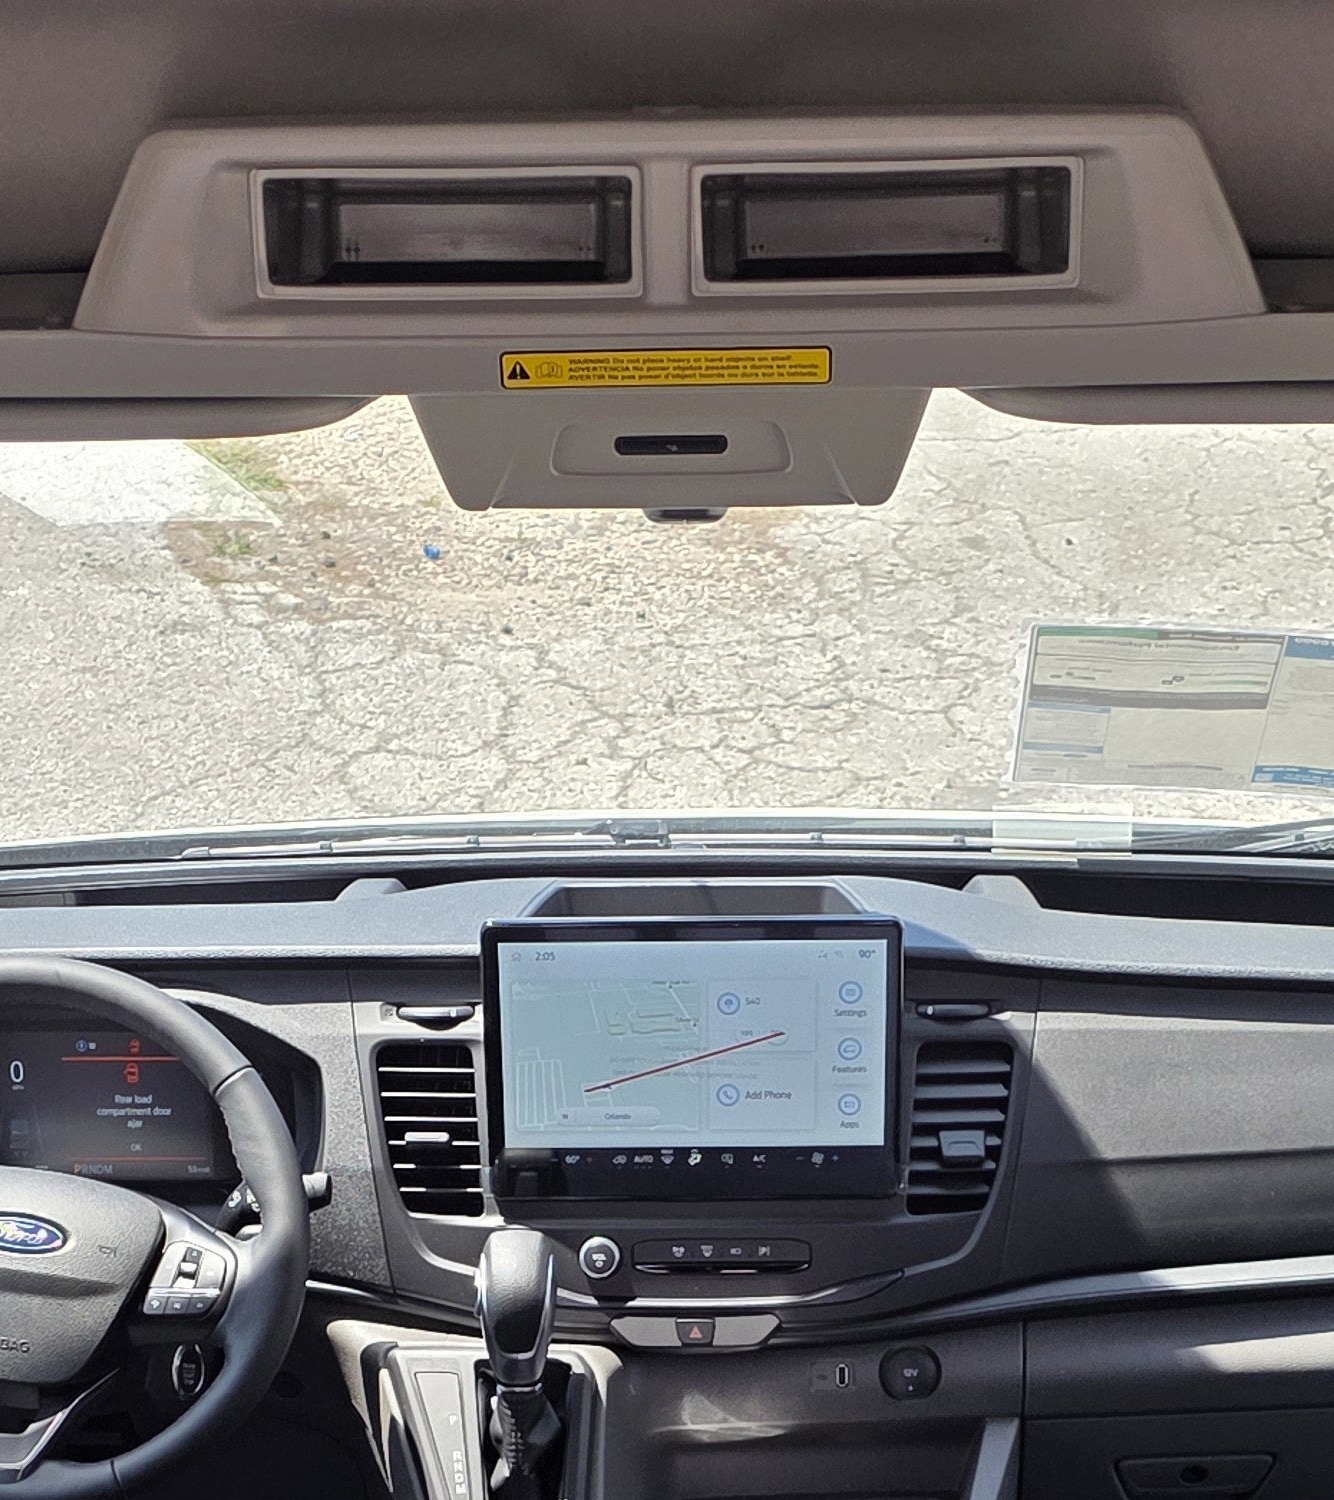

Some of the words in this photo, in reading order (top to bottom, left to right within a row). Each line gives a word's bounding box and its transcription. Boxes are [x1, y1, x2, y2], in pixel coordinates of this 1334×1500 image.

[833, 1008, 868, 1018] Settings
[9, 1059, 25, 1084] 0
[832, 1065, 868, 1074] Features
[114, 1094, 133, 1105] Rear
[134, 1094, 153, 1105] load
[744, 1090, 762, 1100] Add
[764, 1090, 792, 1100] Phone
[96, 1107, 152, 1117] compartment
[153, 1106, 172, 1116] door
[839, 1120, 860, 1130] Apps
